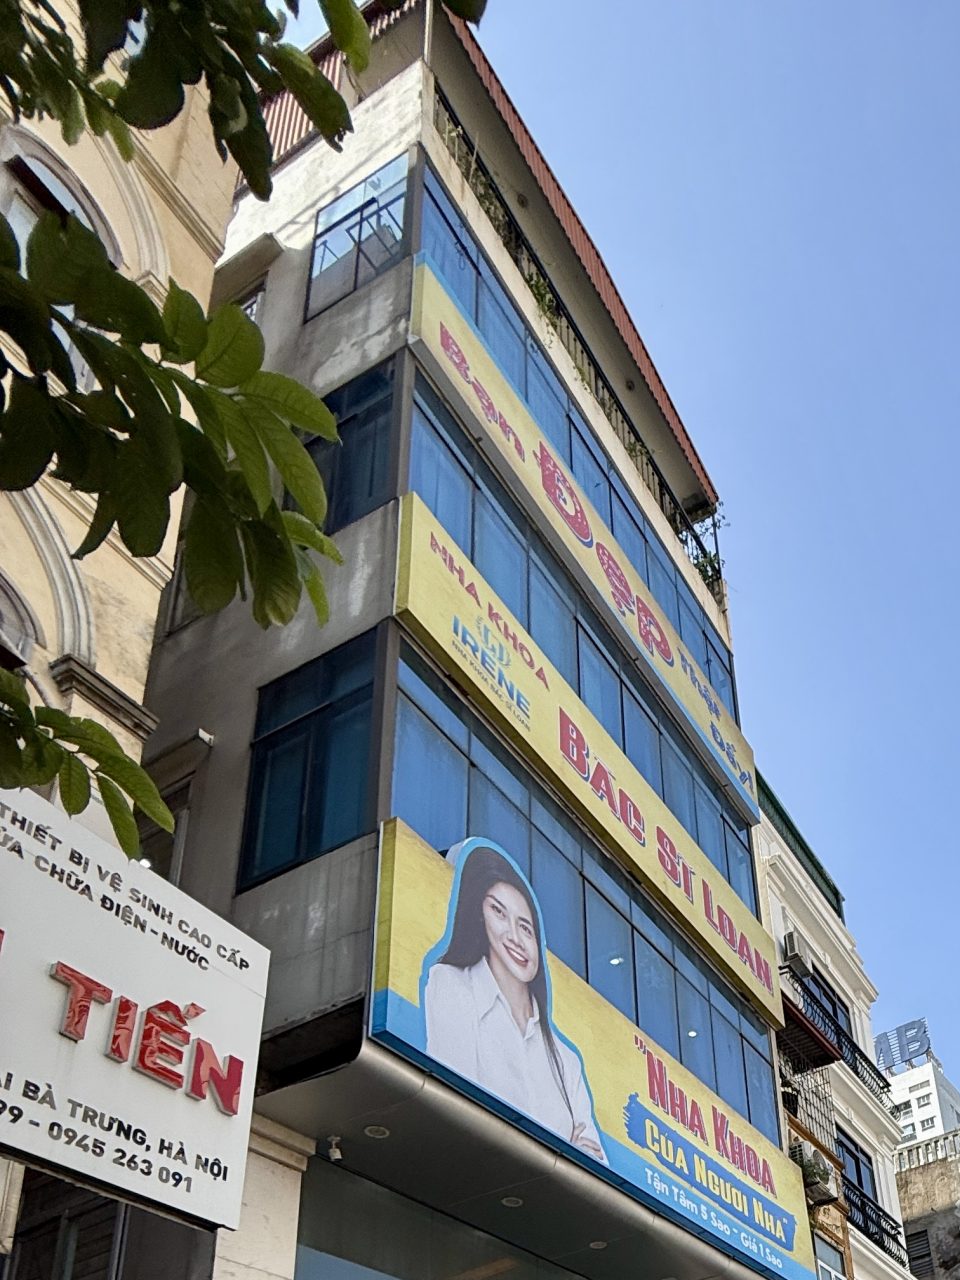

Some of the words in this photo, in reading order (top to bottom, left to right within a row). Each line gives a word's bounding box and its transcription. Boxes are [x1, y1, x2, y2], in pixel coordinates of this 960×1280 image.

[430, 531, 482, 609] NHA
[488, 601, 550, 692] KHOA
[453, 615, 531, 720] IRENE
[0, 802, 62, 852] THIẾT
[69, 848, 90, 874] BỊ
[97, 864, 123, 893] VỆ
[128, 888, 173, 925] SINH
[178, 919, 211, 949] CAO
[217, 944, 249, 970] CẤP
[35, 855, 94, 902] CHỮA
[100, 894, 148, 933] ĐIỆN
[161, 932, 209, 971] NƯỚC
[702, 878, 774, 997] LOAN
[50, 961, 244, 1116] TIẾN
[22, 1079, 57, 1111] BÀ
[67, 1098, 151, 1152] TRƯNG,
[158, 1137, 188, 1165] HÀ
[195, 1153, 229, 1181] NỘI
[47, 1121, 106, 1158] 0945
[112, 1147, 152, 1176] 263
[158, 1166, 193, 1193] 091
[712, 1104, 777, 1199] KHOA
[645, 1167, 669, 1195] Tận
[672, 1185, 699, 1216] Tâm
[700, 1204, 708, 1221] 5
[710, 1211, 731, 1236] Sao
[740, 1232, 758, 1254] Giá
[759, 1243, 764, 1258] 1
[765, 1249, 783, 1270] Sao
